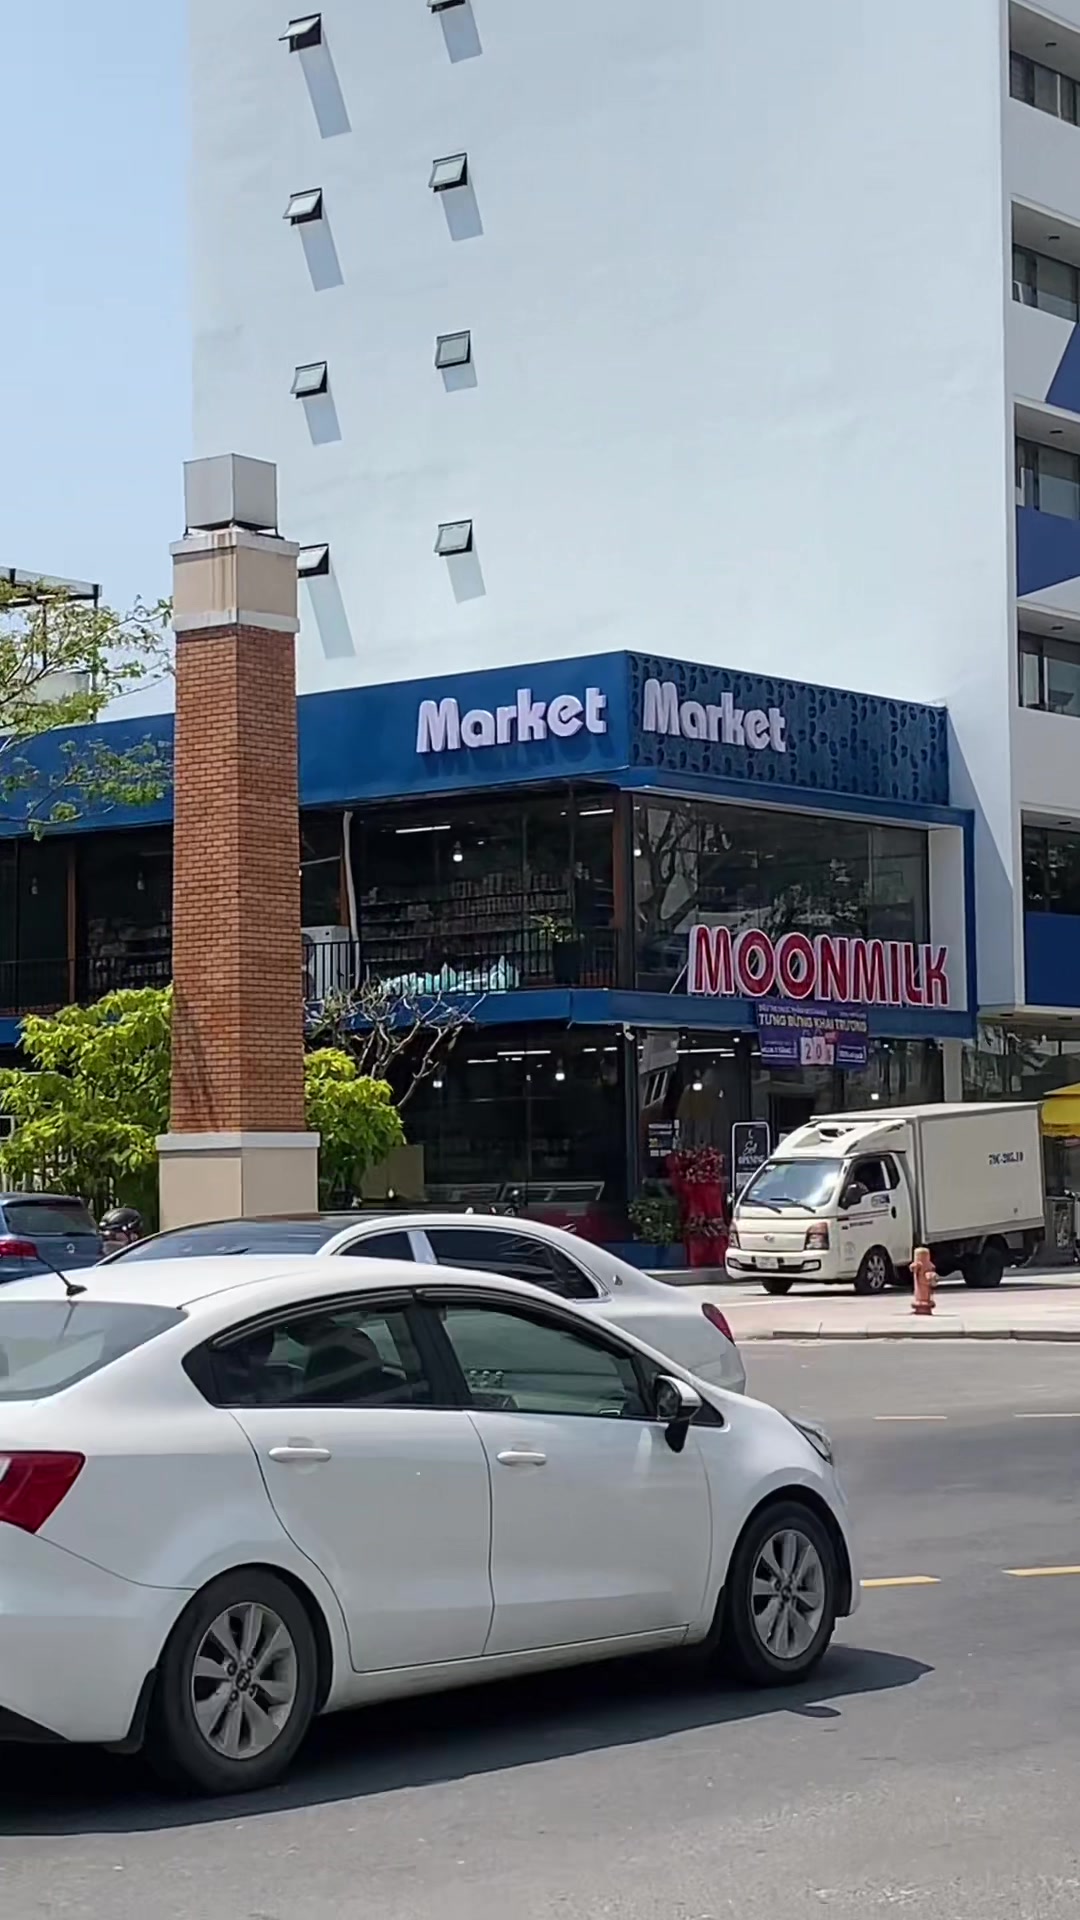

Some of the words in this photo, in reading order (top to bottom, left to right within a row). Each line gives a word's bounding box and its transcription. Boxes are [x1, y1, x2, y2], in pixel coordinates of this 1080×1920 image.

[416, 686, 607, 753] Market
[643, 678, 786, 752] Market
[687, 924, 949, 1007] MOONMILK
